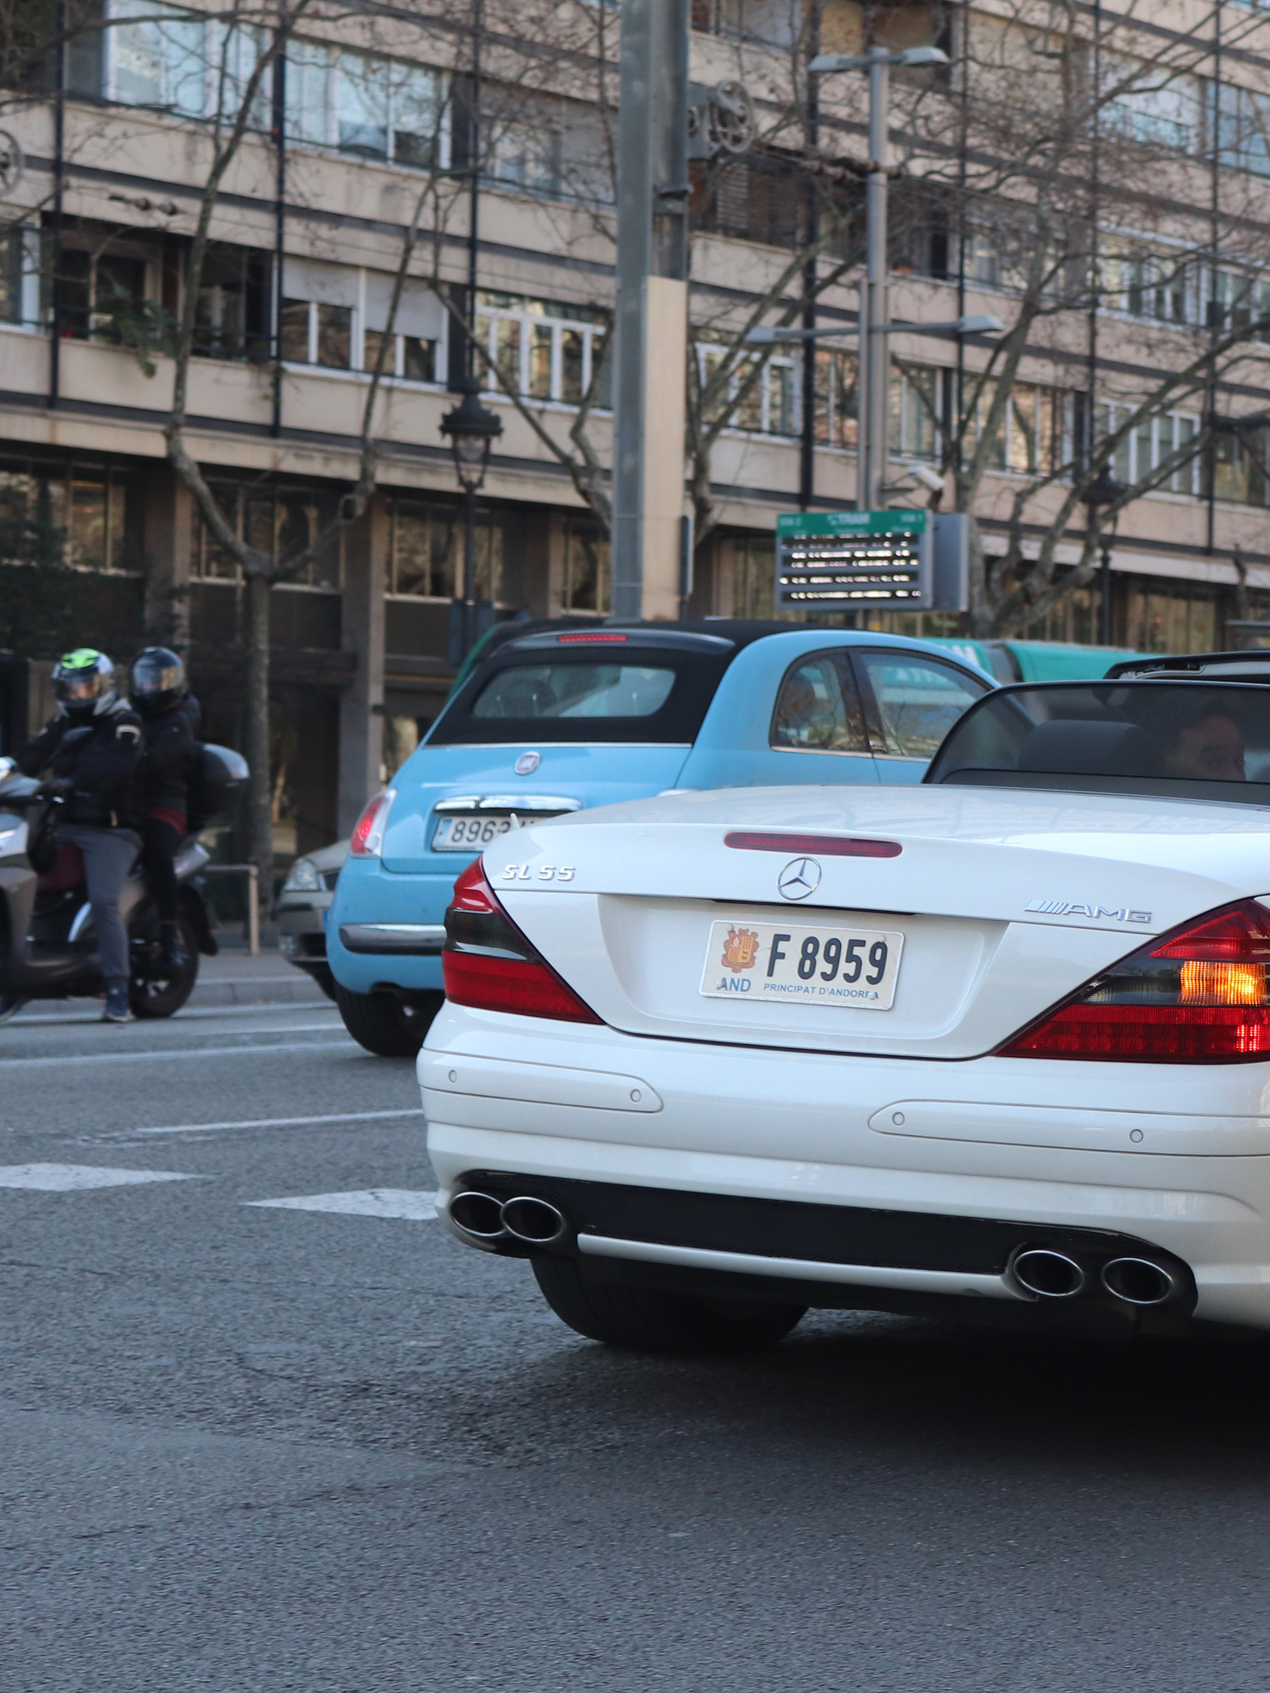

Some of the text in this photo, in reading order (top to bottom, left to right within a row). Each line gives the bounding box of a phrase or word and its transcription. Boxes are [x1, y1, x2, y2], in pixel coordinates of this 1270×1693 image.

[501, 864, 576, 882] SL 55
[1062, 903, 1153, 924] AMG
[766, 934, 888, 985] F 8959
[717, 977, 752, 992] AND
[763, 983, 817, 995] PRINCIPAT
